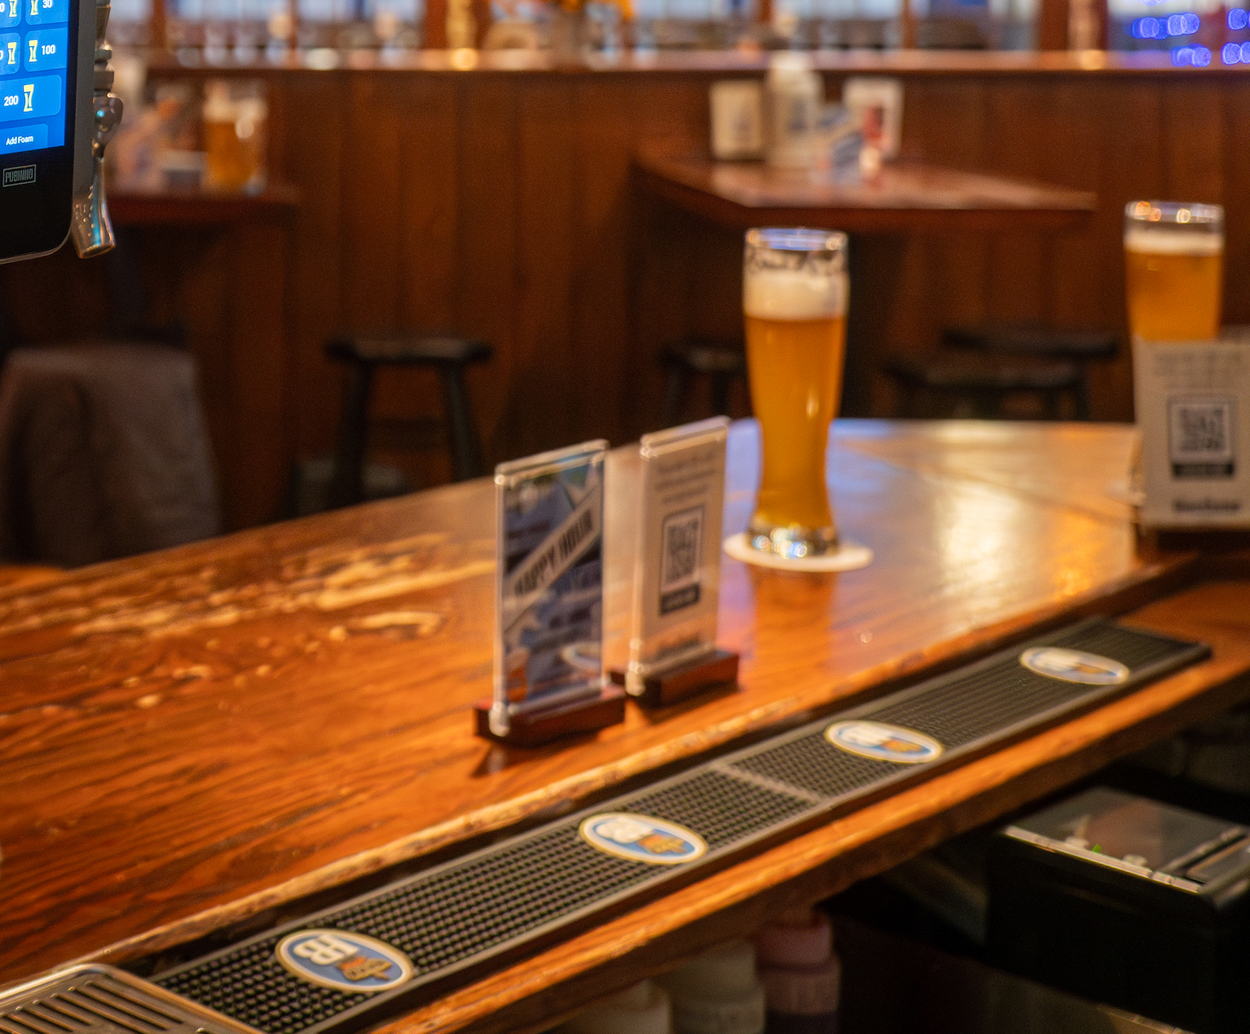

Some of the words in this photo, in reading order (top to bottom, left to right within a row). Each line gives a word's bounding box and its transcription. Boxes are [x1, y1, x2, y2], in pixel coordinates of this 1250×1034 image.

[41, 44, 56, 55] 100
[3, 95, 19, 106] 200
[5, 135, 17, 146] Add
[17, 134, 33, 144] Foam
